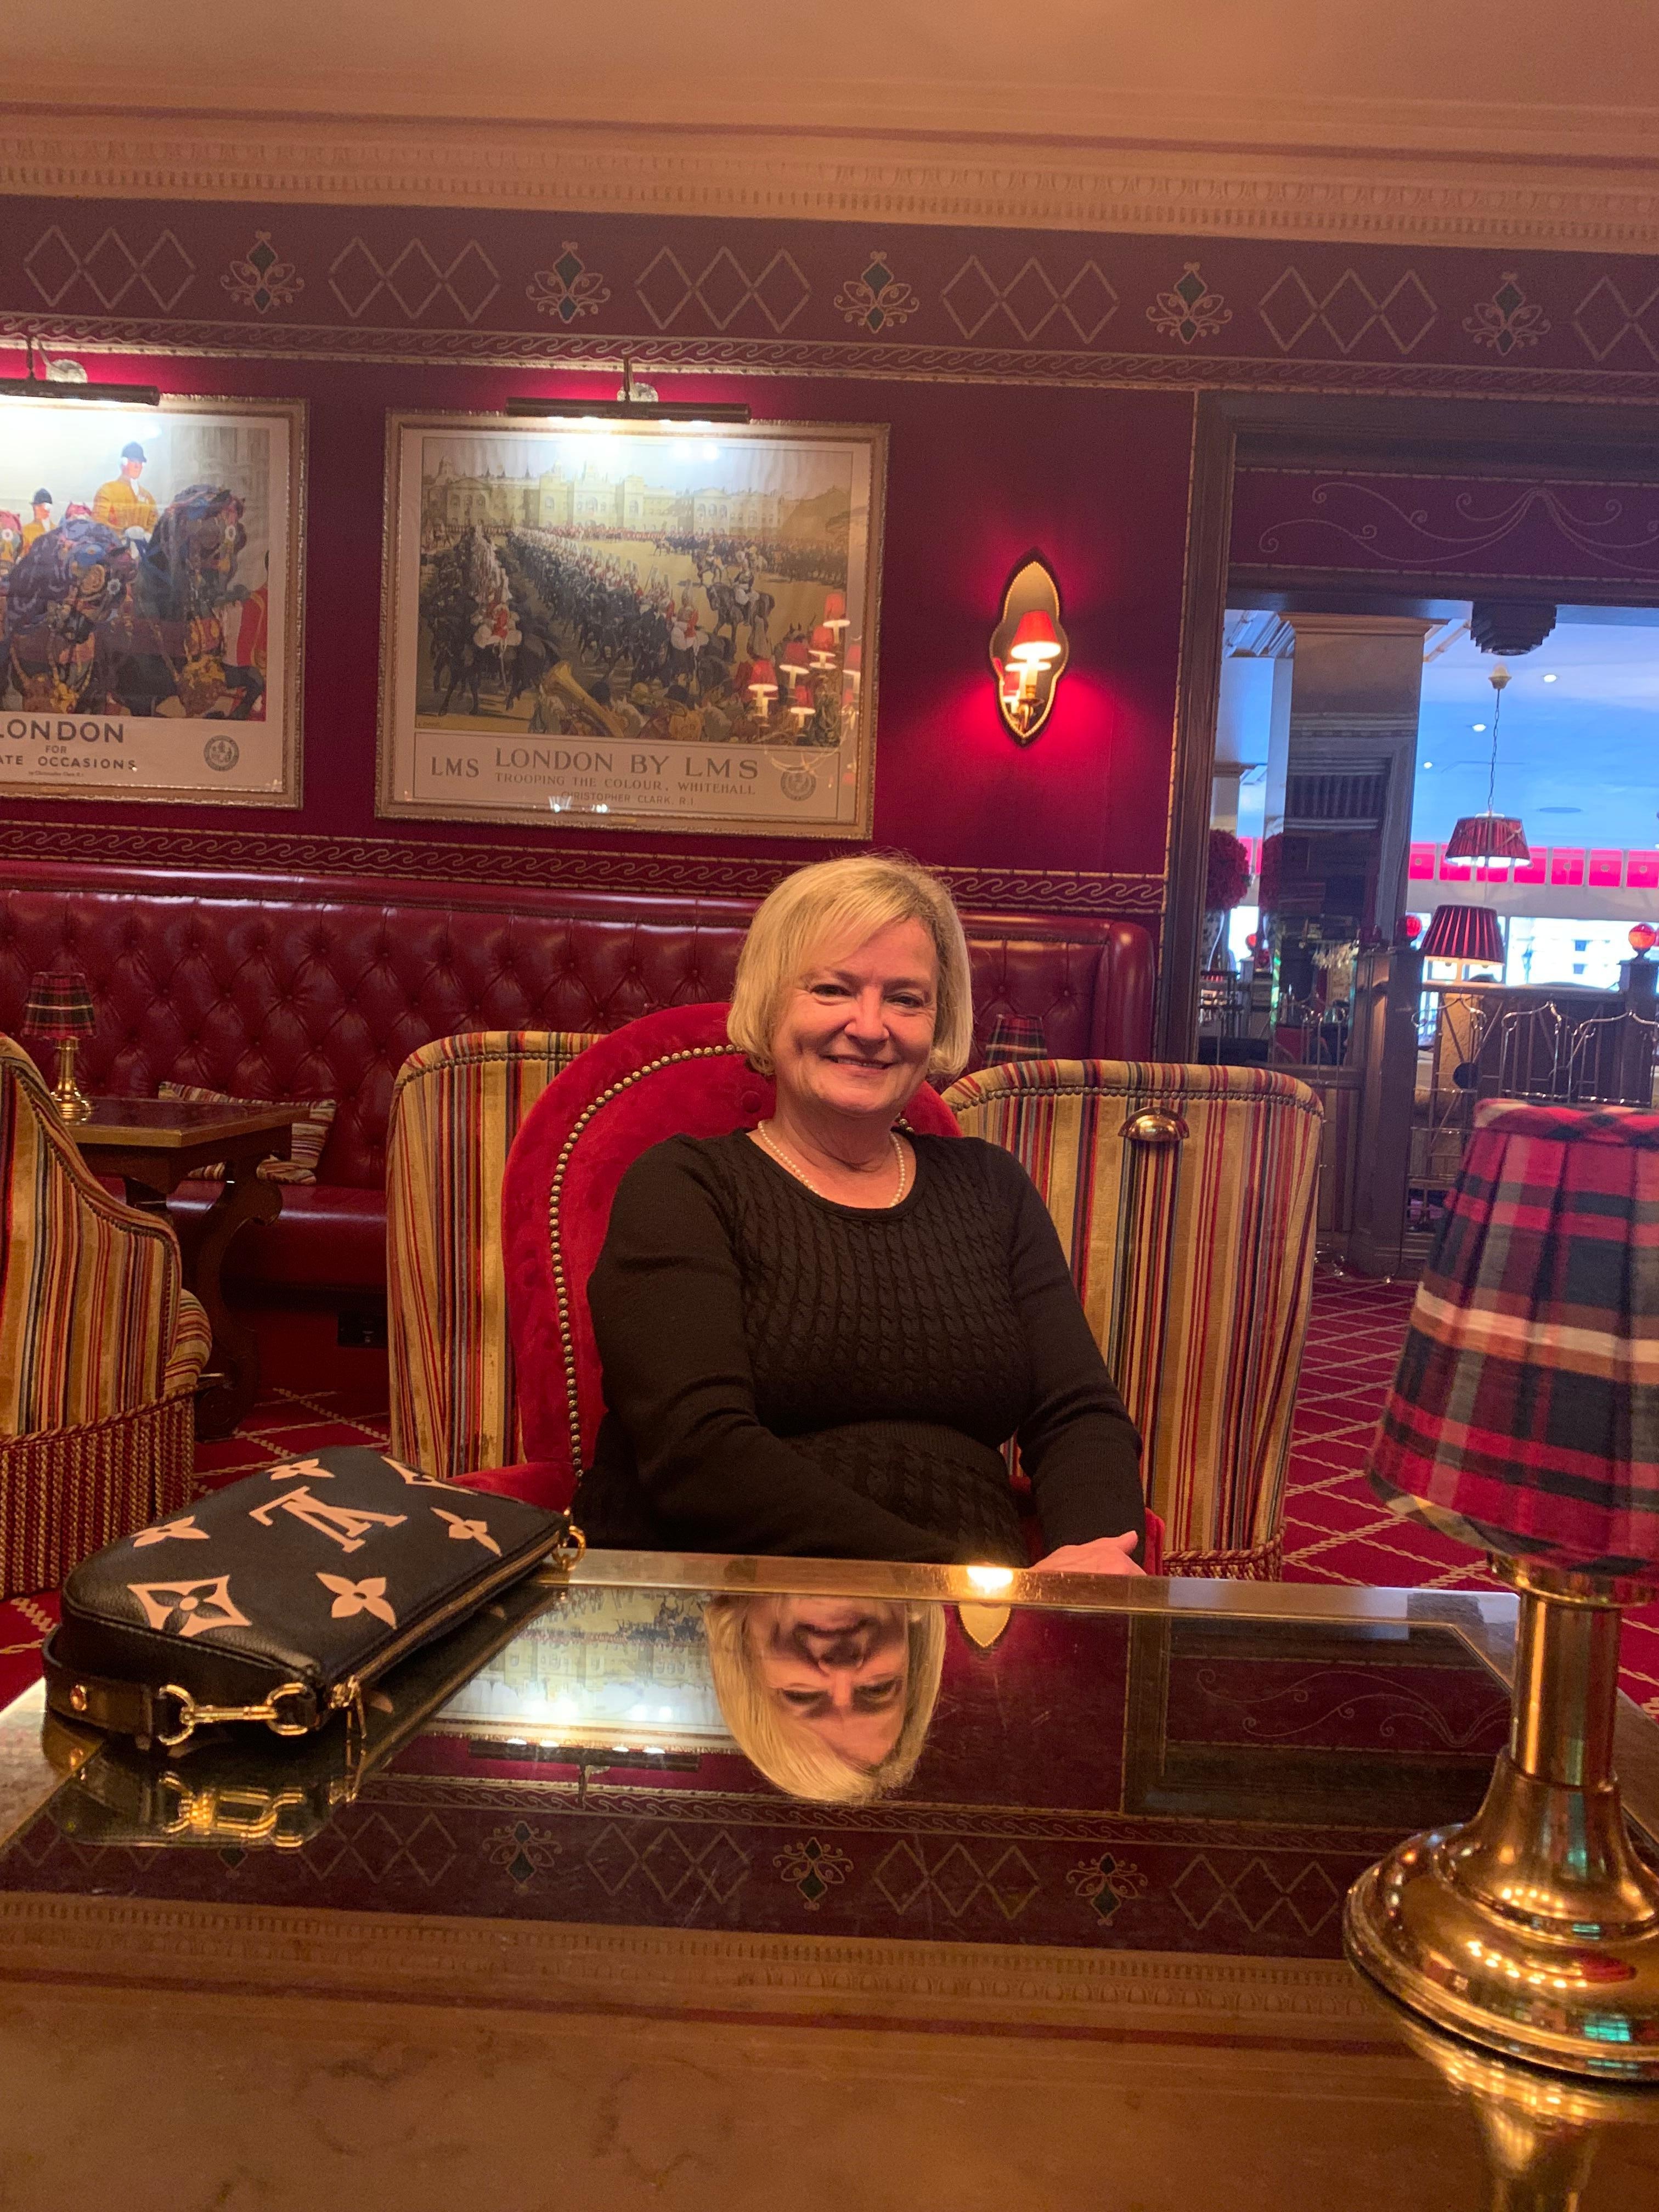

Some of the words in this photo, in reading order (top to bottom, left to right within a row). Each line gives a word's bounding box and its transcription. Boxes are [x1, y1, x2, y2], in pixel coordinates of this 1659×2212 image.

[0, 719, 123, 743] ONDON
[46, 745, 67, 753] FOR
[38, 756, 136, 770] OCCASIONS
[431, 757, 479, 777] LMS
[496, 747, 613, 772] LONDON
[631, 754, 669, 775] BY
[686, 757, 758, 779] LMS
[495, 772, 565, 786] TROOPING
[573, 777, 596, 787] THE
[678, 781, 755, 795] WHITEHALL
[561, 791, 630, 802] CHRISTOPHER
